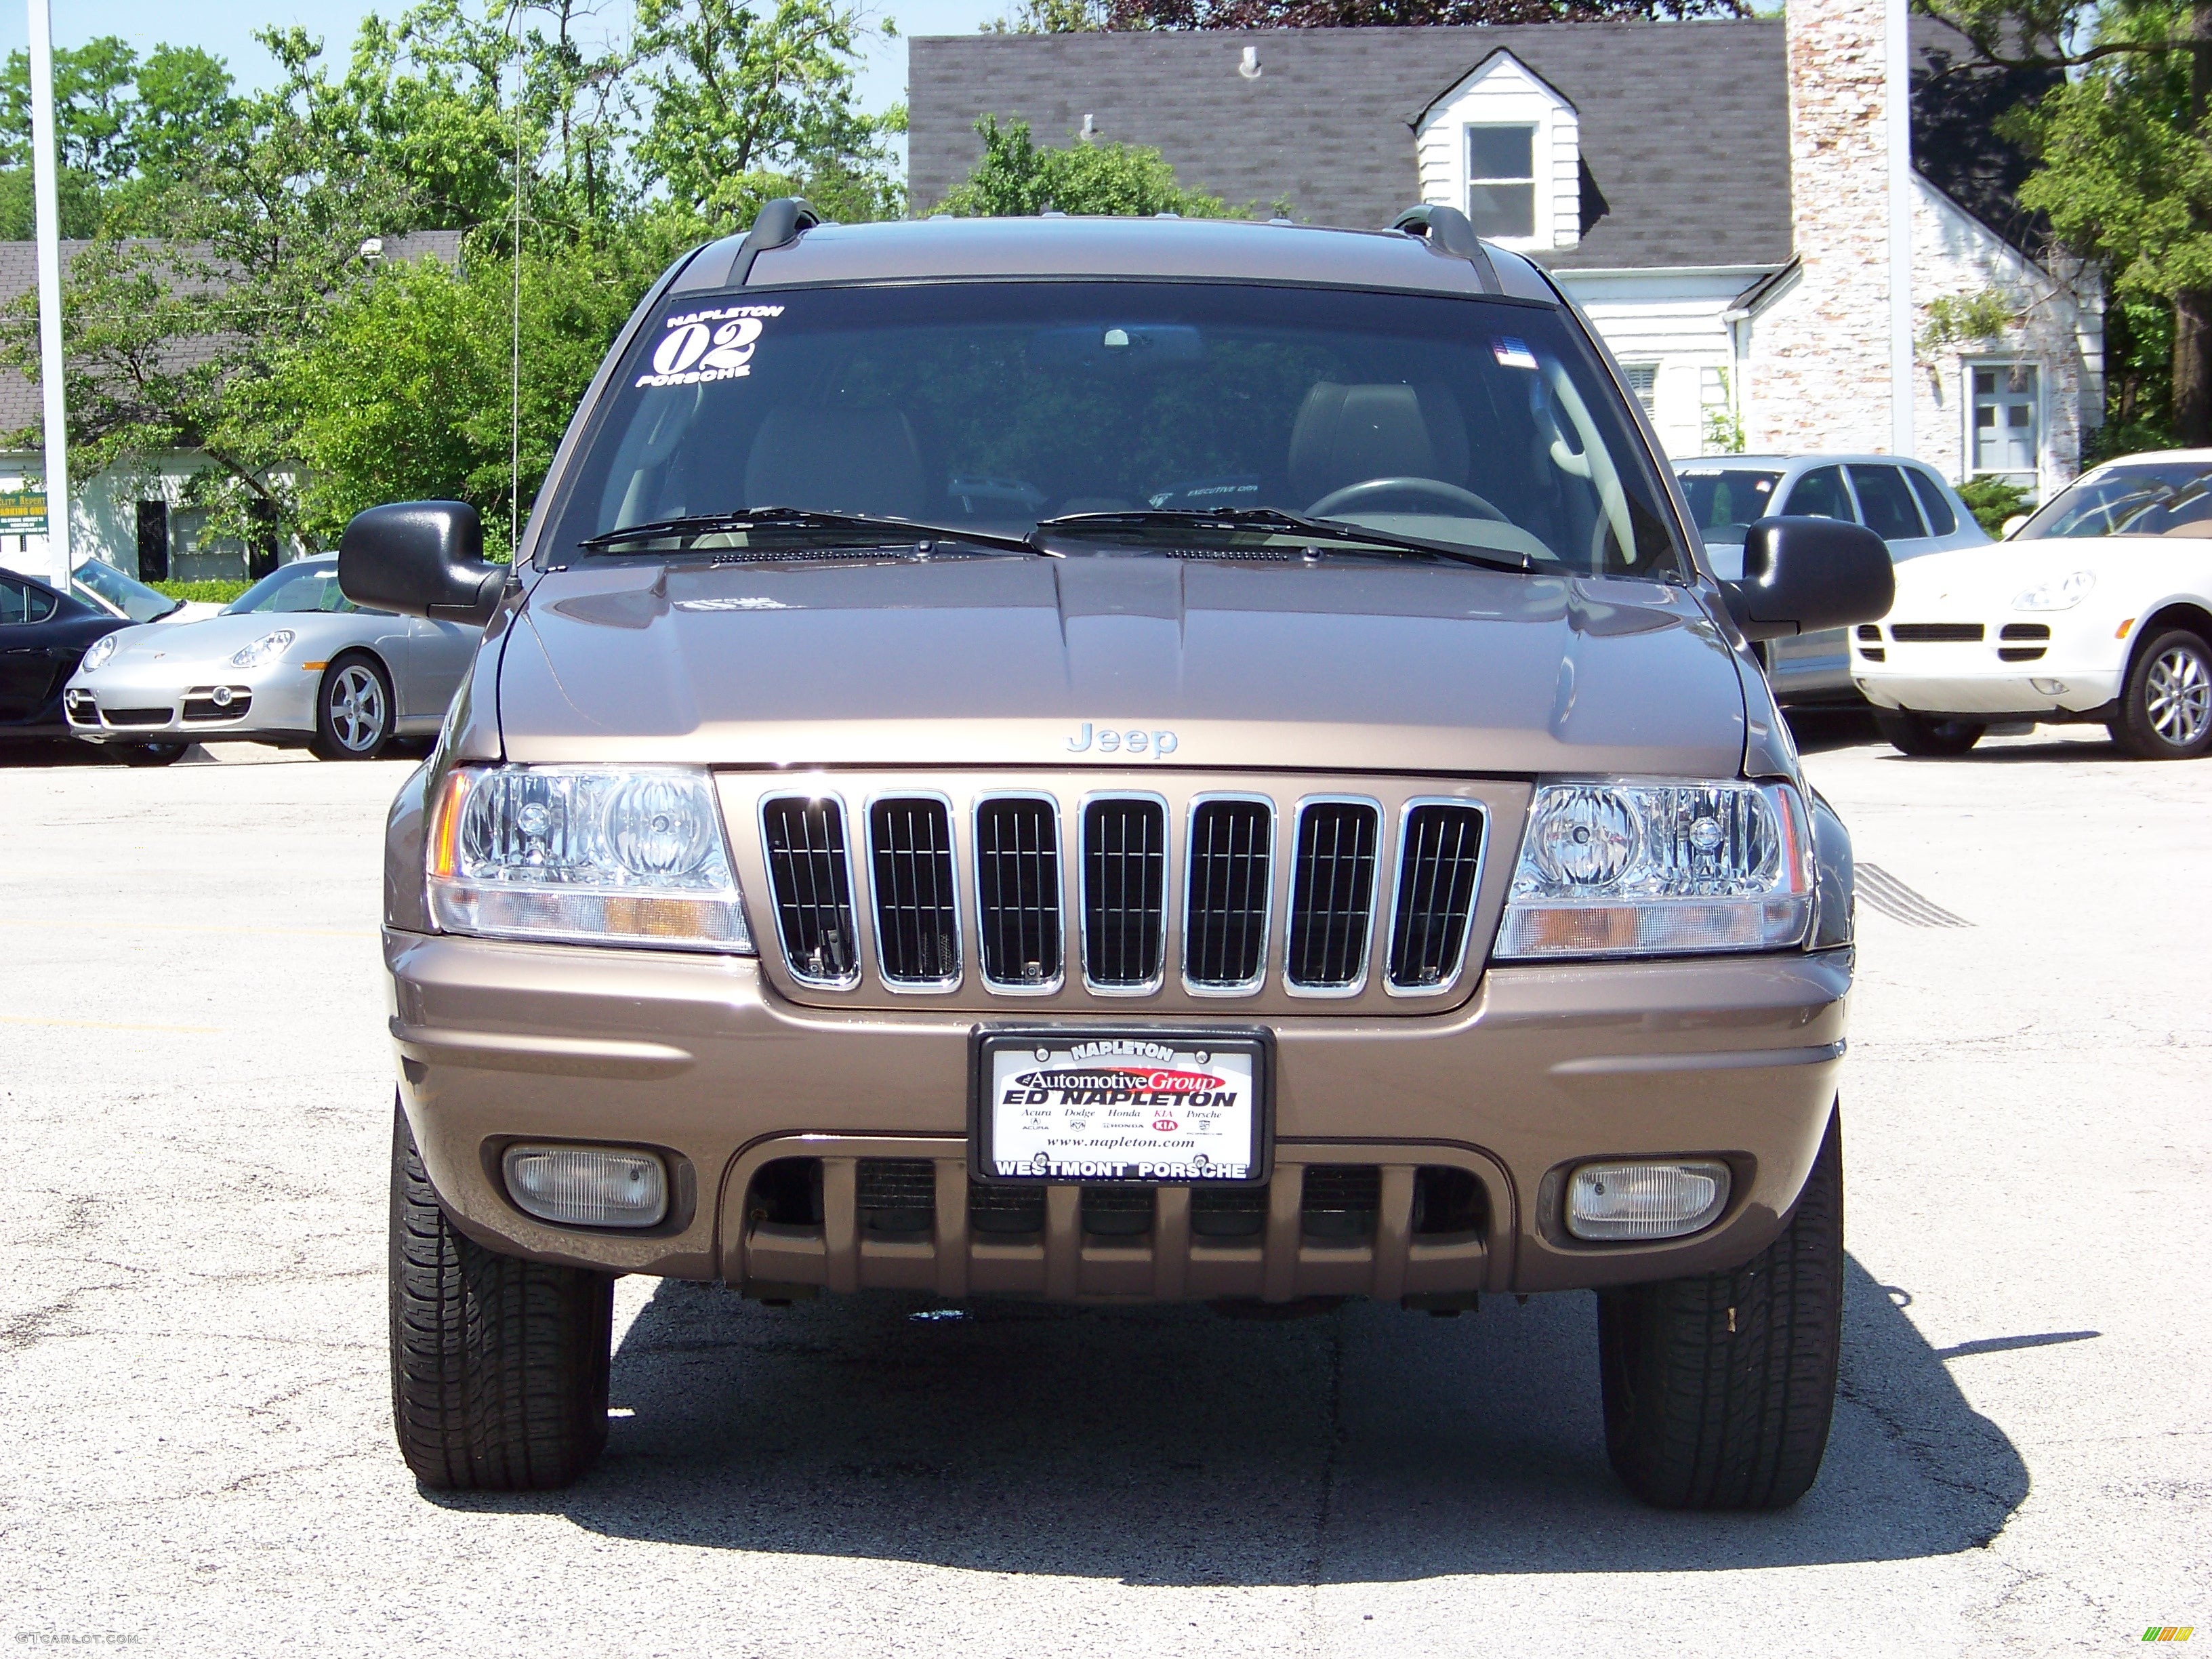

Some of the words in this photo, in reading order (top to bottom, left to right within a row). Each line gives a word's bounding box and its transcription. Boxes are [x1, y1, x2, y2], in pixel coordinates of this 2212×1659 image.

[667, 306, 785, 328] NAPLETON
[653, 317, 763, 375] 02
[635, 365, 751, 388] PORSCHE
[1063, 722, 1178, 760] Jeep
[1070, 1040, 1174, 1062] NAPLETON
[1002, 1090, 1050, 1105] ED
[1060, 1090, 1237, 1107] NAPLETON
[1021, 1109, 1052, 1117] Acura
[1065, 1109, 1096, 1118] Dodge
[1108, 1109, 1141, 1118] Honda
[1153, 1109, 1173, 1118] KIA
[1187, 1110, 1222, 1119] Porsche
[1155, 1122, 1176, 1130] KIA
[1047, 1137, 1195, 1150] www.napleton.com
[996, 1160, 1128, 1177] WESTMONT
[1138, 1162, 1248, 1179] PORSCHE
